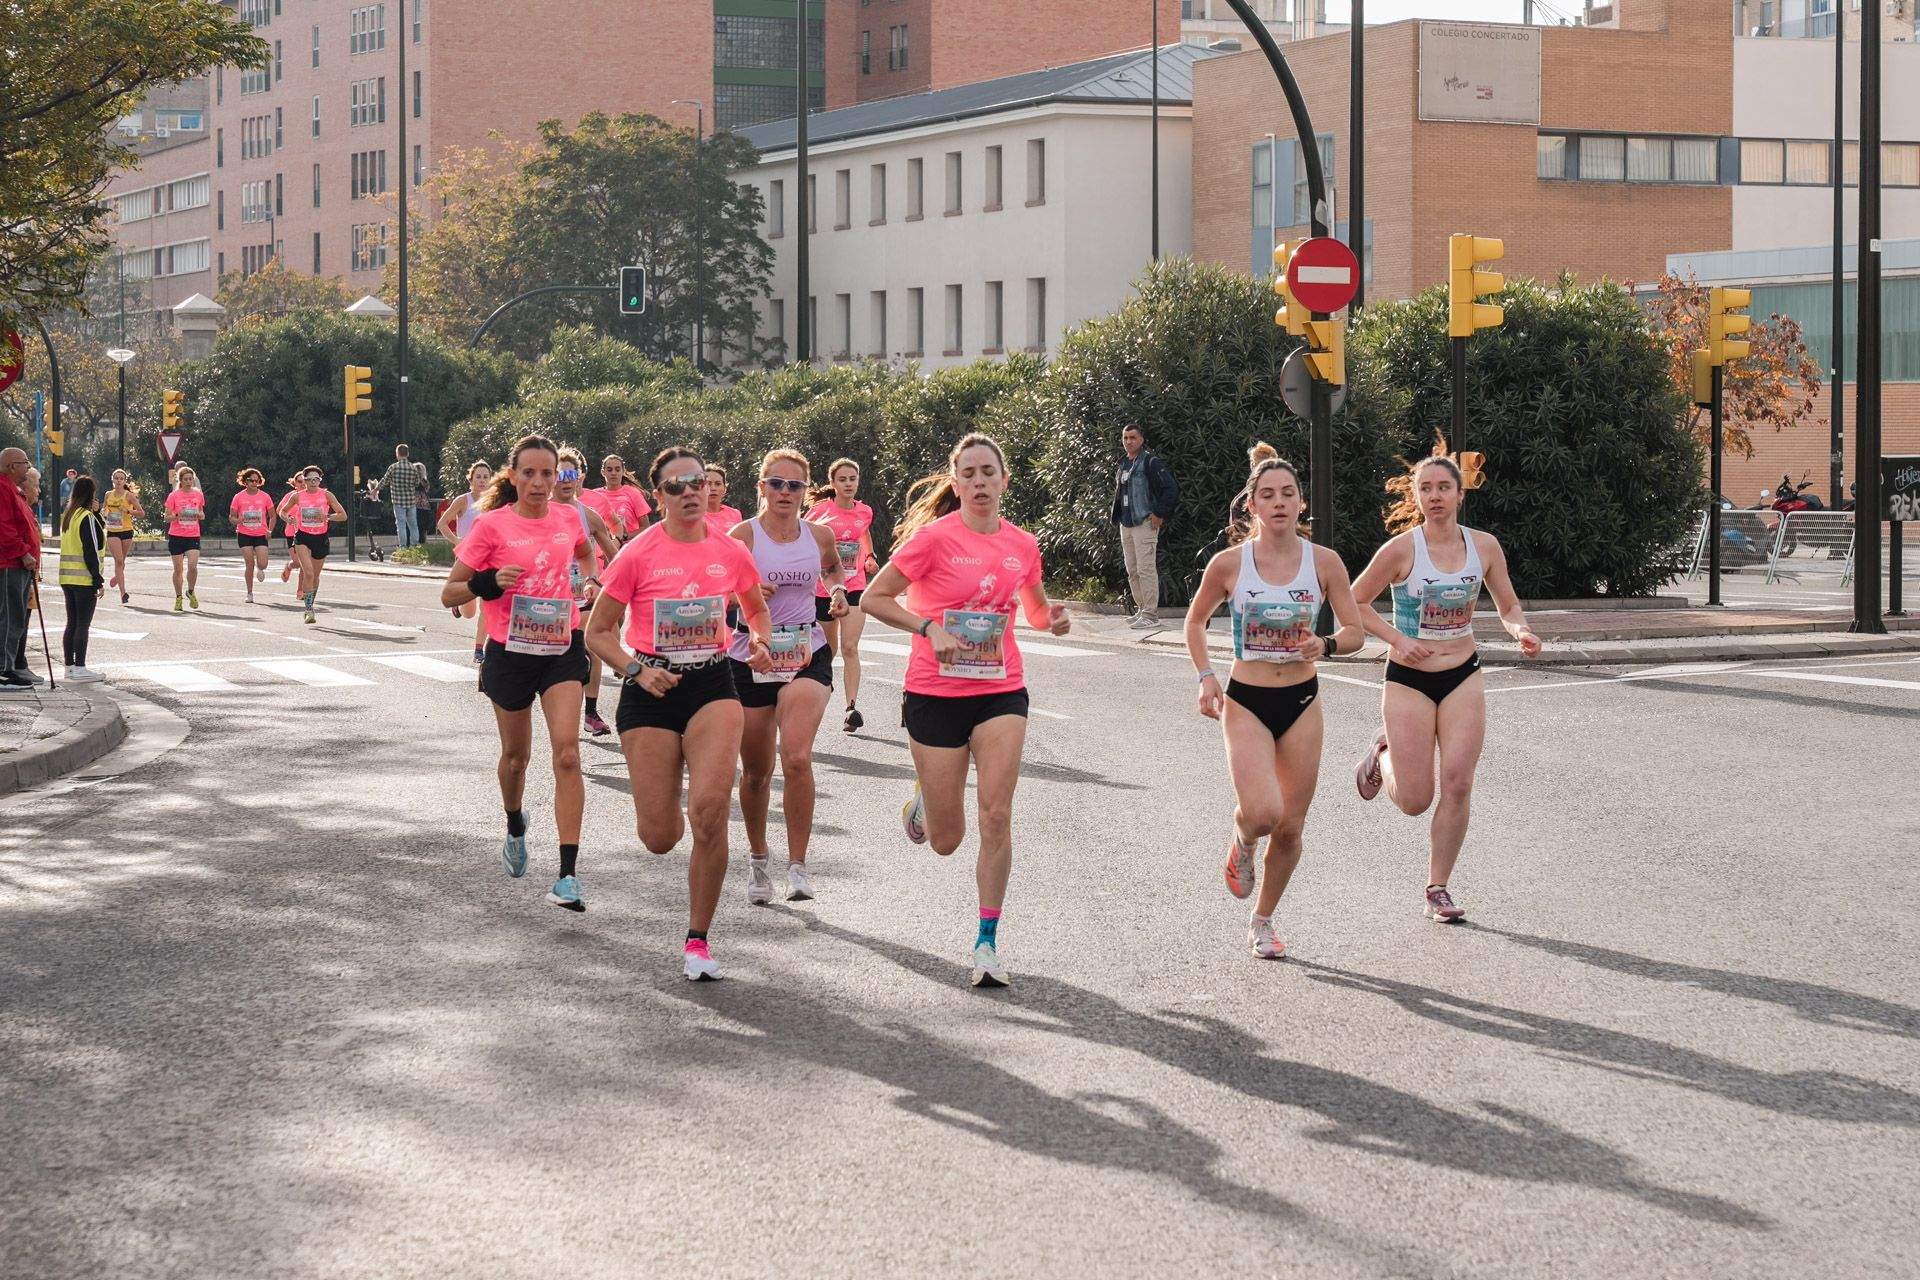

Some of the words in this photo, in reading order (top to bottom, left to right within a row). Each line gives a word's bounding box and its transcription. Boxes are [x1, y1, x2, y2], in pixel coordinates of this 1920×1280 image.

[1431, 28, 1469, 38] COLEGIO
[1472, 31, 1530, 41] CONCERTADO
[653, 568, 684, 577] OYSHO
[767, 571, 812, 582] OYSHO
[678, 626, 703, 637] 016
[1266, 628, 1290, 639] 016
[635, 653, 666, 668] NIKE
